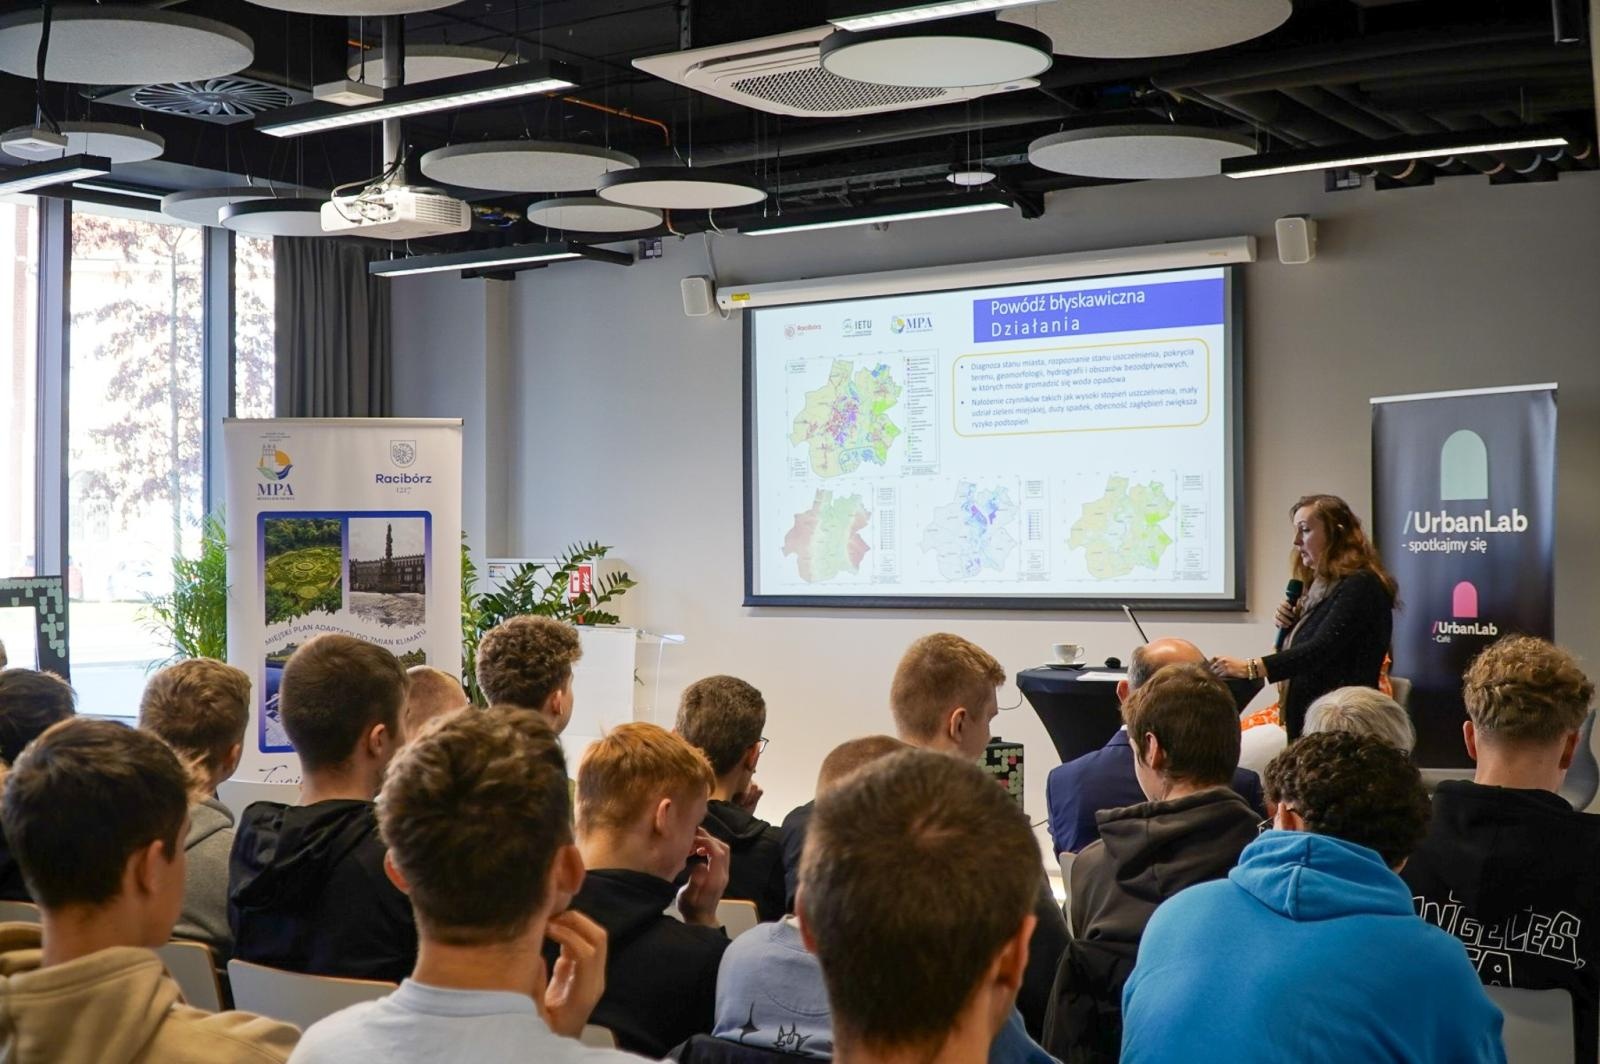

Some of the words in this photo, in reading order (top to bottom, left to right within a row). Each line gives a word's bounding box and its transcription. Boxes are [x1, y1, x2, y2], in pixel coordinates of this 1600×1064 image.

[991, 296, 1046, 315] Powódź
[1050, 290, 1145, 312] błyskawiczna
[855, 320, 872, 330] IETU
[906, 317, 933, 329] MPA
[991, 317, 1080, 337] Działania
[971, 362, 1001, 371] Diagnoza
[1002, 361, 1021, 369] stanu
[1048, 356, 1090, 365] rozpoznanie
[1092, 353, 1111, 361] stanu
[1163, 348, 1194, 358] pokrycia
[1046, 367, 1084, 377] hydrografii
[1088, 364, 1122, 373] obszarów
[979, 383, 1004, 393] których
[1005, 382, 1024, 390] może
[1024, 380, 1060, 391] gromadzić
[1061, 379, 1071, 388] się
[1072, 377, 1092, 386] woda
[1093, 375, 1126, 386] opadowa
[1005, 395, 1040, 405] czynników
[1041, 393, 1062, 402] takich
[1063, 393, 1074, 402] jak
[1075, 391, 1099, 400] wysoki
[1100, 388, 1127, 399] stopień
[1179, 385, 1198, 395] mały
[971, 408, 992, 417] udział
[992, 406, 1015, 416] zieleni
[1048, 404, 1064, 414] duży
[1094, 399, 1128, 410] obecność
[1129, 398, 1164, 410] zagłębień
[1165, 397, 1198, 408] zwiększa
[971, 420, 993, 429] ryzyko
[994, 418, 1029, 428] podtopień
[375, 472, 432, 484] Racibórz
[257, 483, 294, 496] MPA
[1408, 537, 1469, 554] spotkajmy
[1470, 536, 1488, 554] się
[265, 629, 292, 645] MIEJSKI
[293, 624, 313, 632] PLAN
[395, 629, 427, 645] KLIMATU
